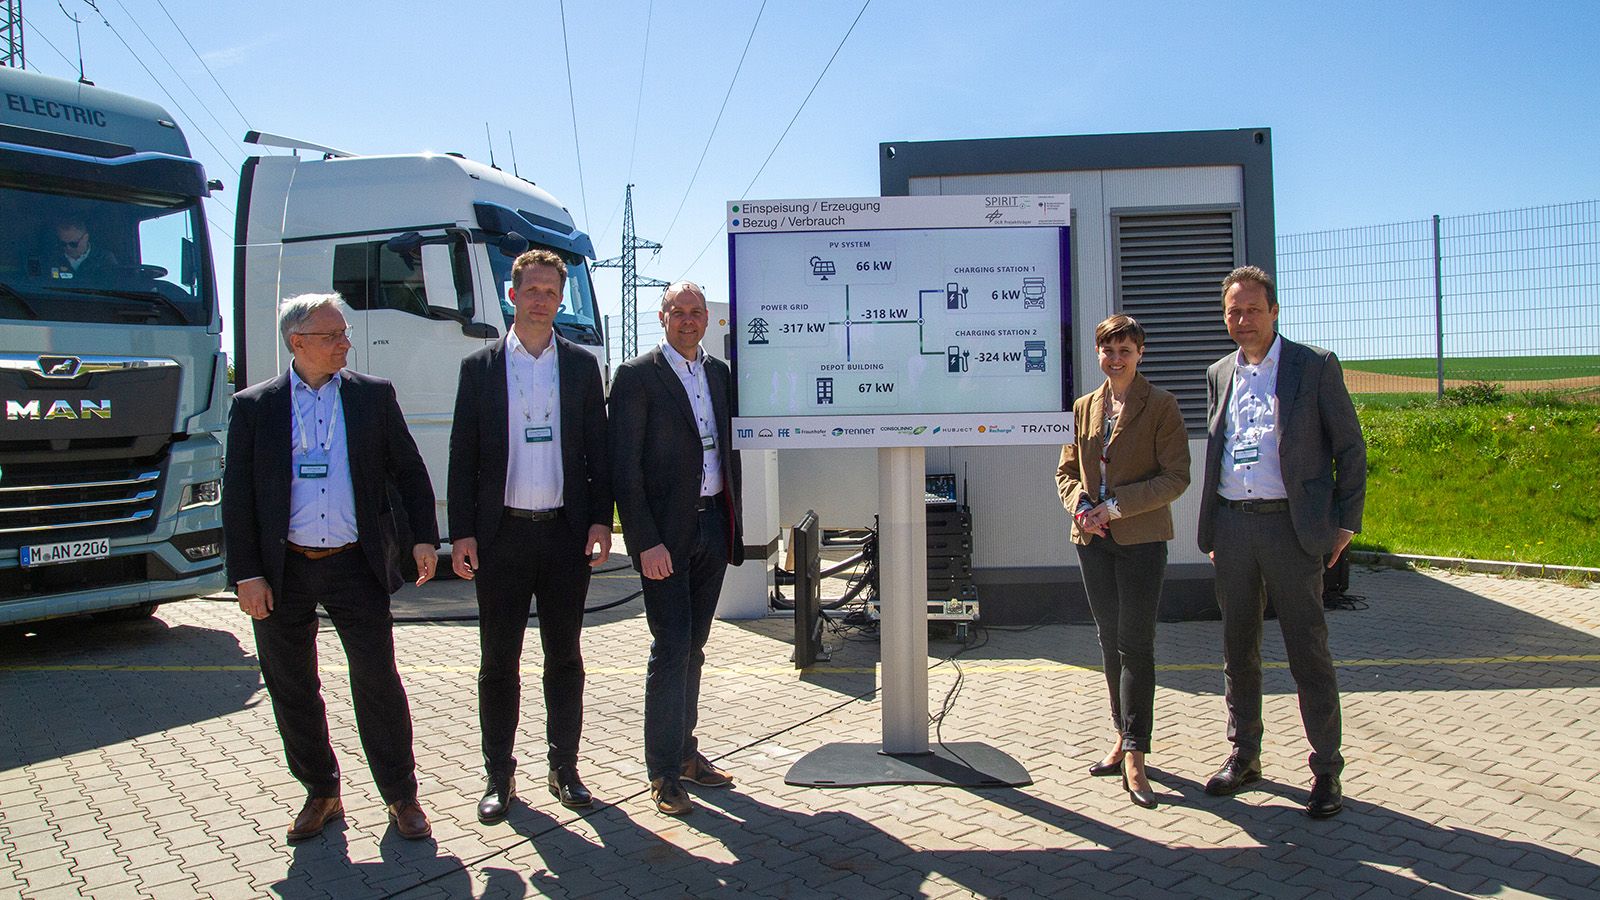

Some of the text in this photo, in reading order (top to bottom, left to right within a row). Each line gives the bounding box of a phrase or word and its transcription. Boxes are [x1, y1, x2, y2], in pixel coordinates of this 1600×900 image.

[6, 93, 107, 127] ELECTRIC
[985, 196, 1018, 207] SPIRIT
[742, 203, 810, 215] Einspeisung
[821, 201, 881, 213] Erzeugung
[742, 217, 777, 229] Bezug
[788, 216, 845, 227] Verbrauch
[856, 261, 892, 271] 66 kW
[991, 290, 1020, 300] 6 kW
[861, 309, 908, 319] -318 kW
[778, 323, 826, 334] -317 kW
[974, 352, 1021, 362] -324 kW
[847, 363, 884, 371] BUILDING
[858, 383, 894, 393] 67 kW
[6, 400, 112, 420] MAN
[1021, 424, 1070, 433] TRATON
[31, 541, 108, 562] M AN 2206
